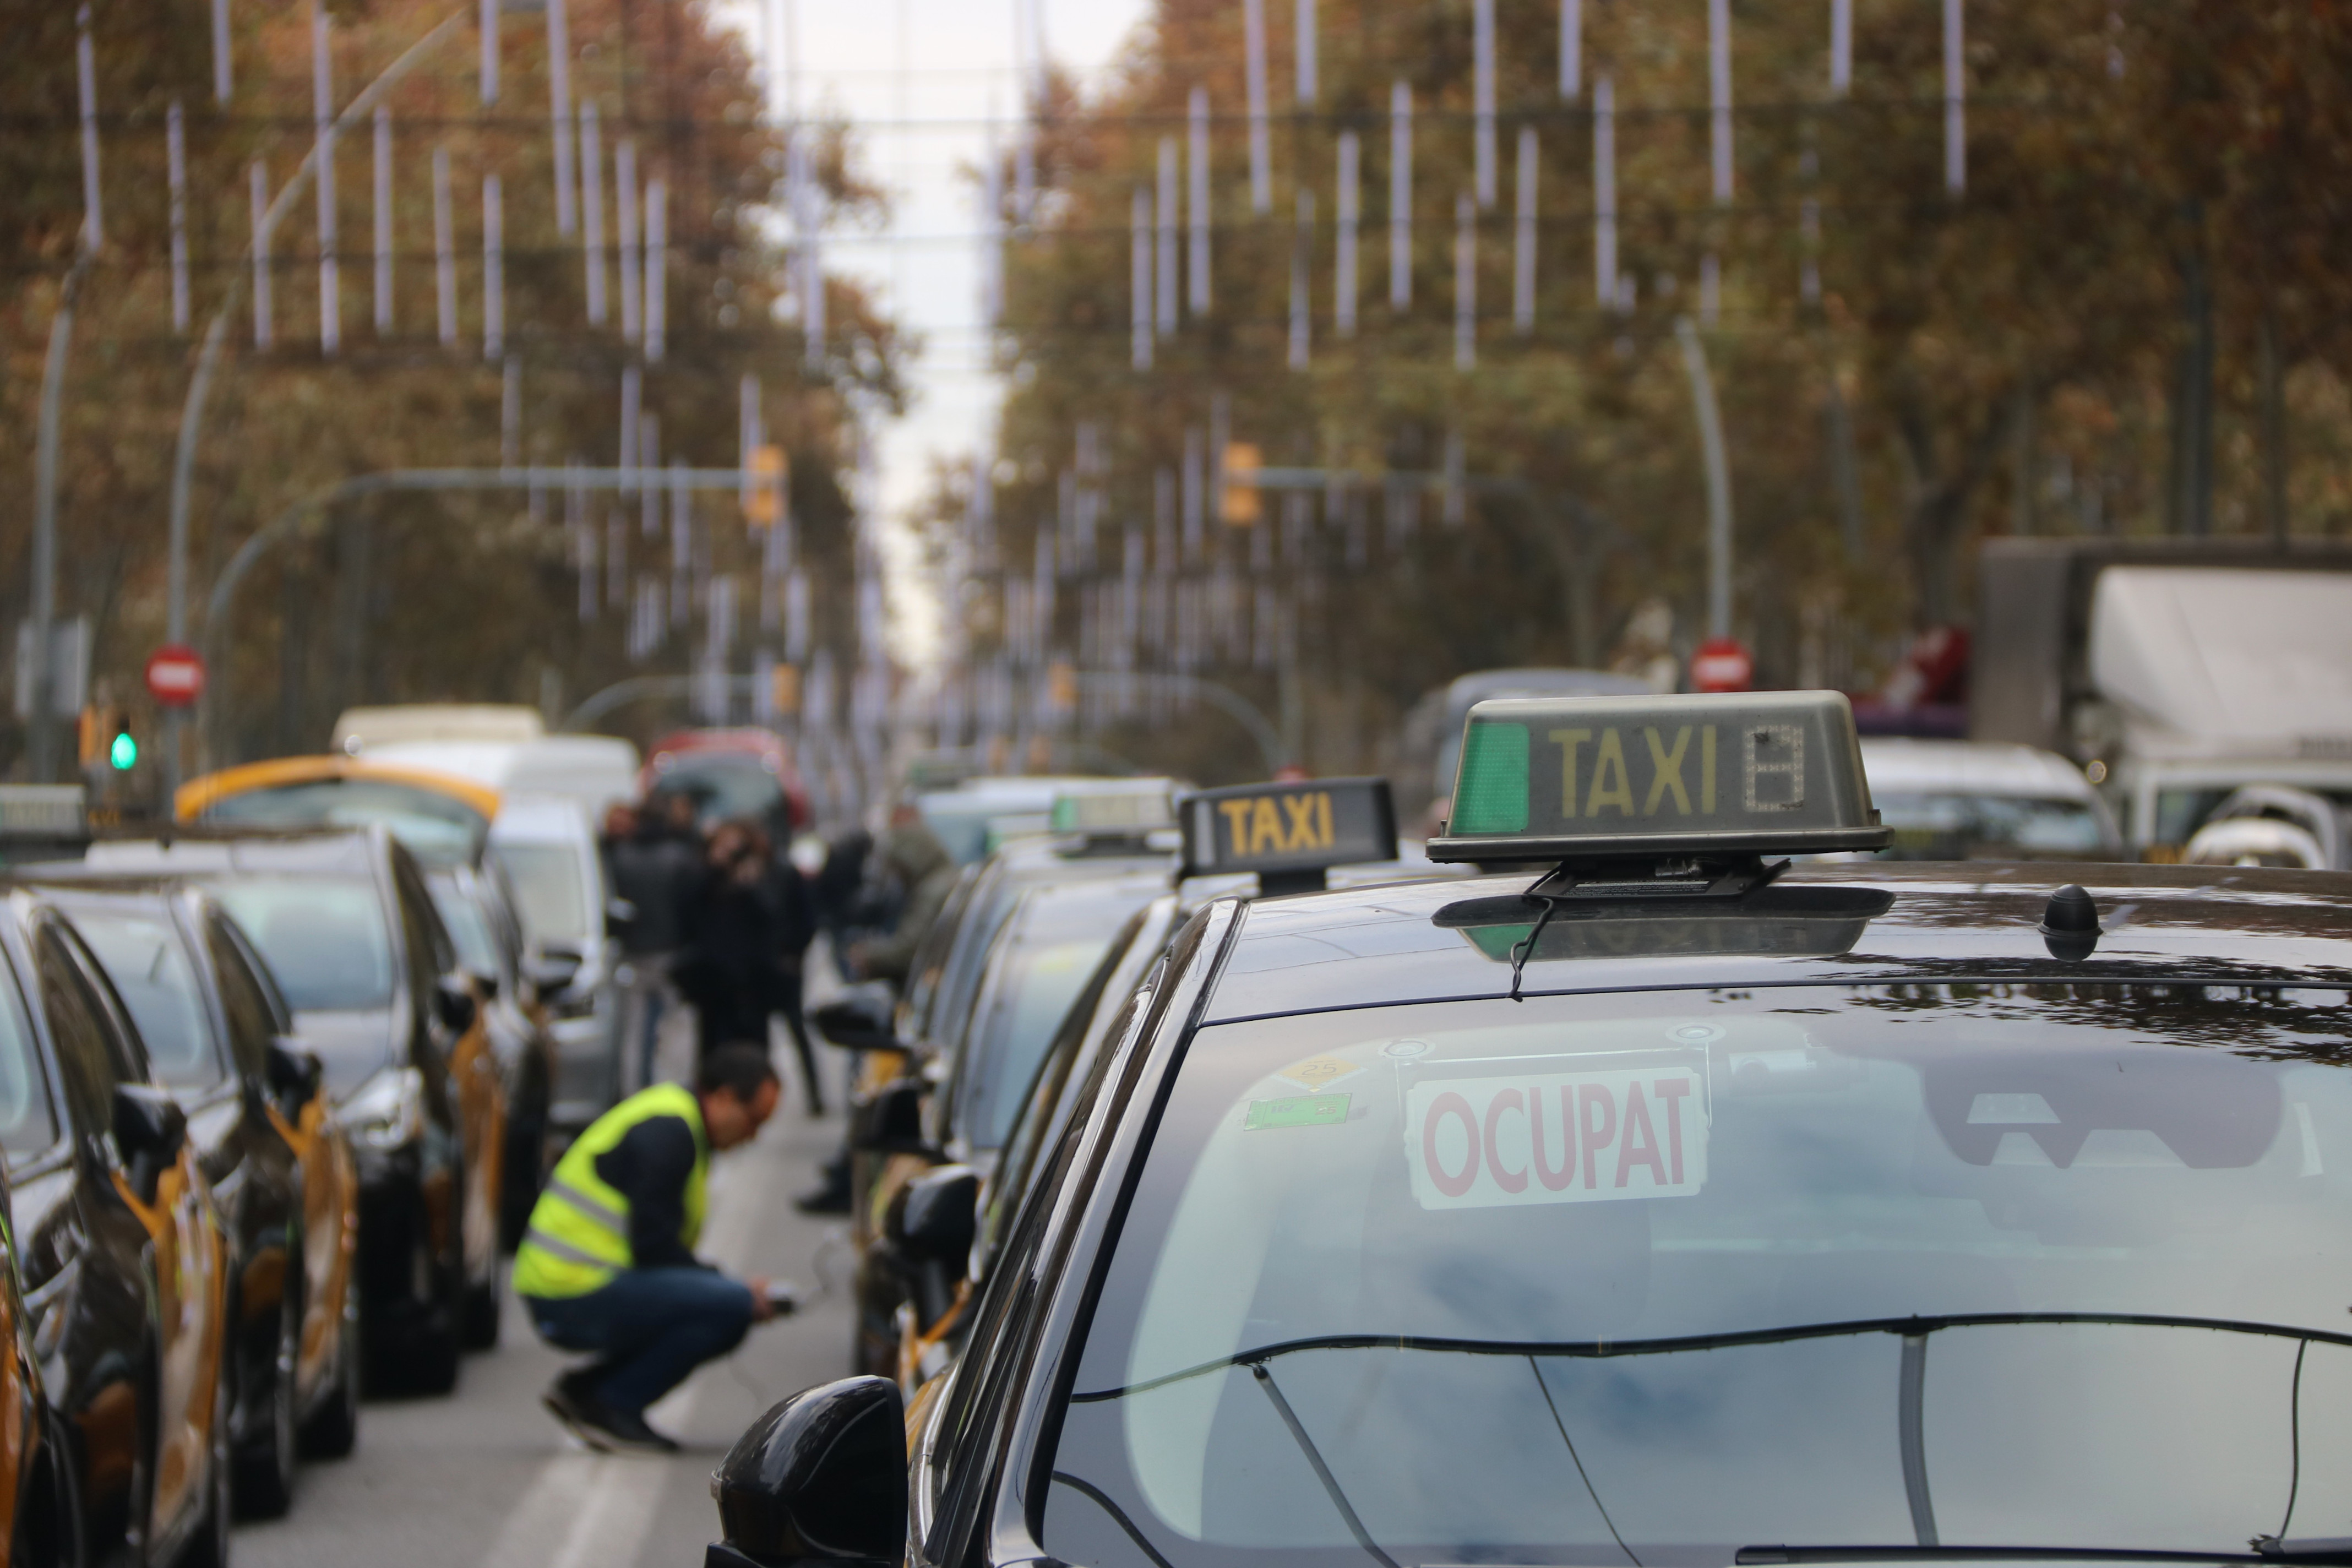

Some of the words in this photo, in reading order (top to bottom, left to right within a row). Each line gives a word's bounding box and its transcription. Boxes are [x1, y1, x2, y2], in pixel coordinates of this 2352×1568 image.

[1548, 725, 1717, 818] TAXI
[1219, 791, 1336, 857] TAXI
[1302, 1063, 1337, 1076] 25
[1423, 1078, 1690, 1197] OCUPAT
